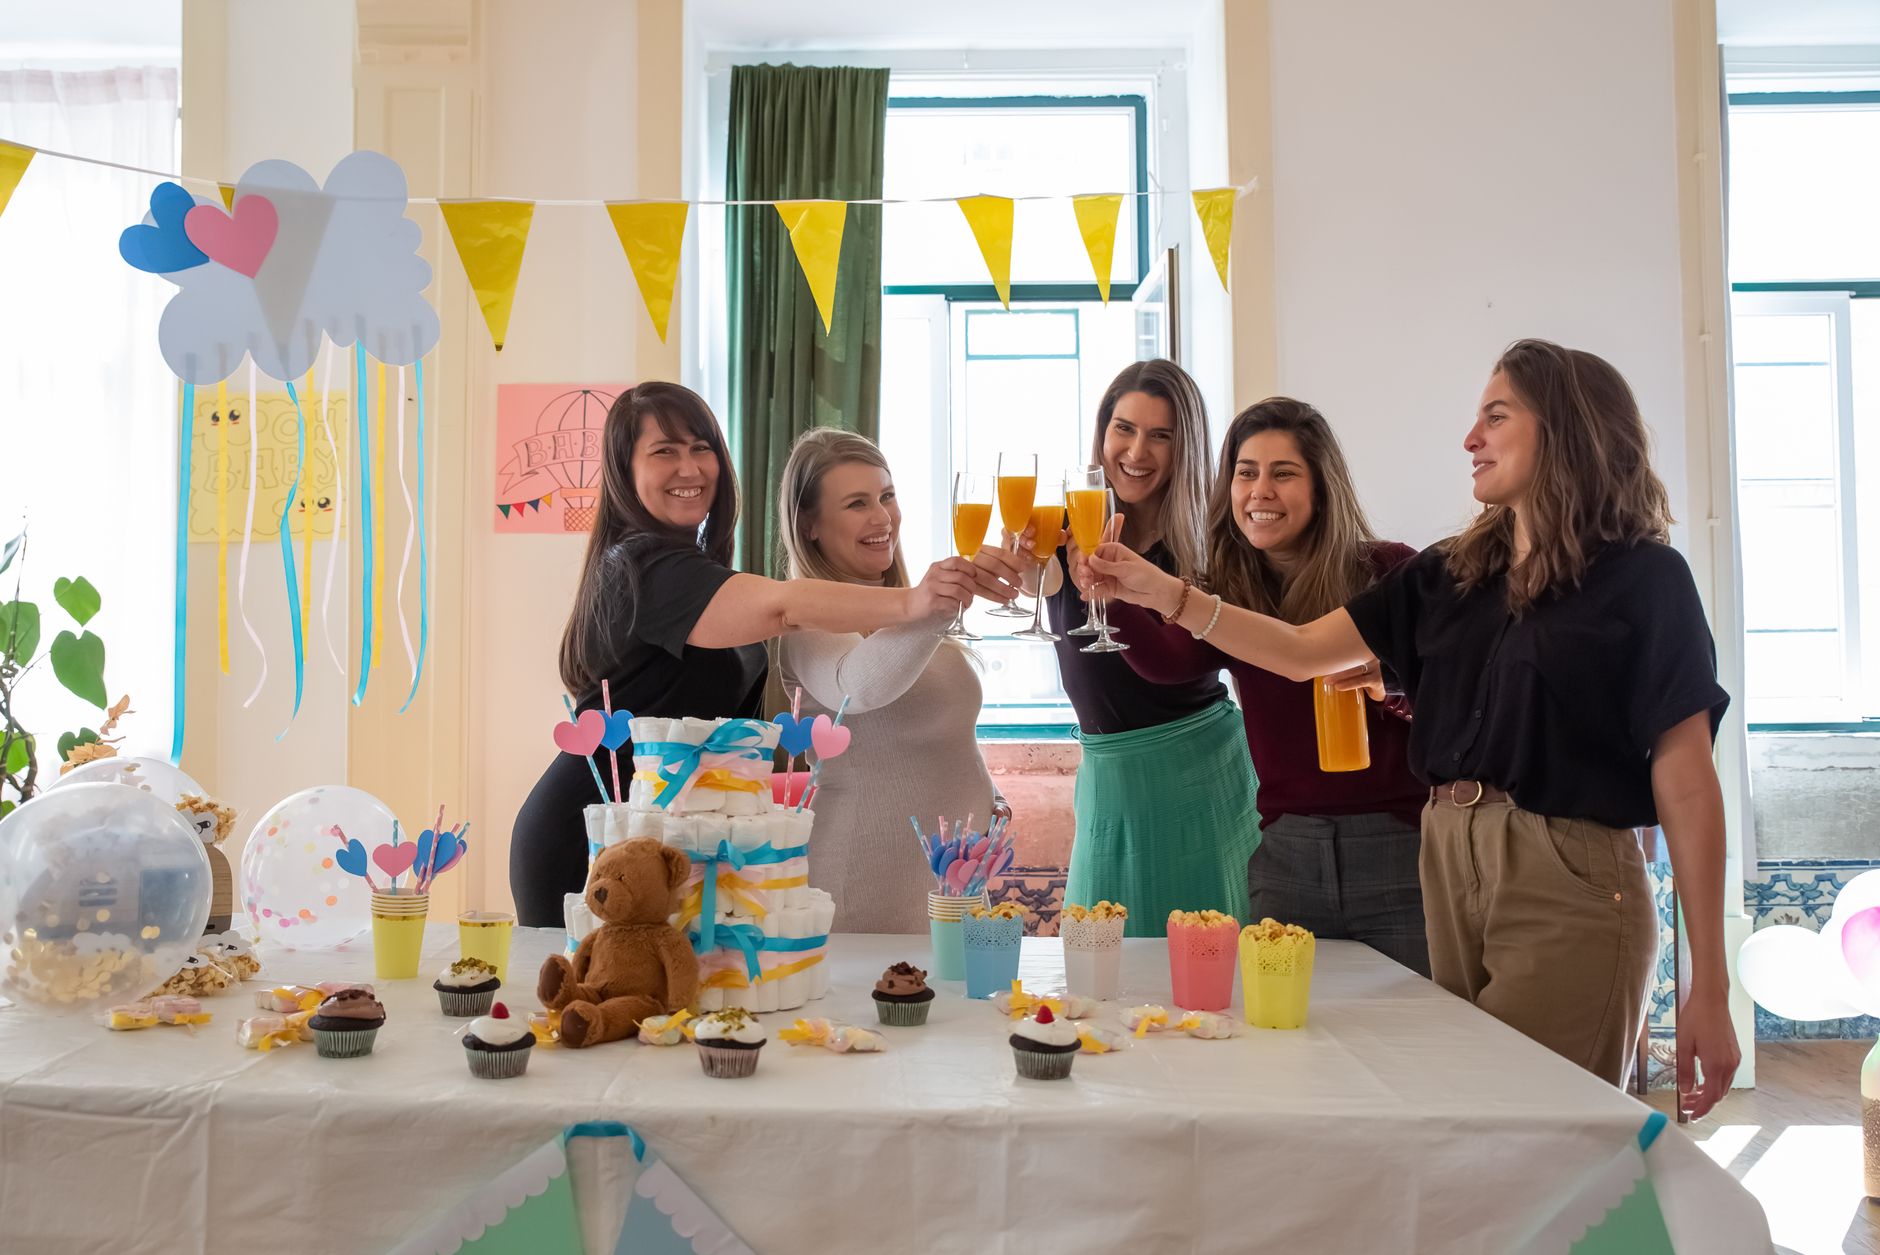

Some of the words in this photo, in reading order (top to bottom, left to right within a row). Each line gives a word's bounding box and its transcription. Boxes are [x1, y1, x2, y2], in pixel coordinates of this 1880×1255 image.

[272, 408, 338, 444] OH
[524, 431, 600, 467] BAB
[203, 447, 340, 494] BABY
